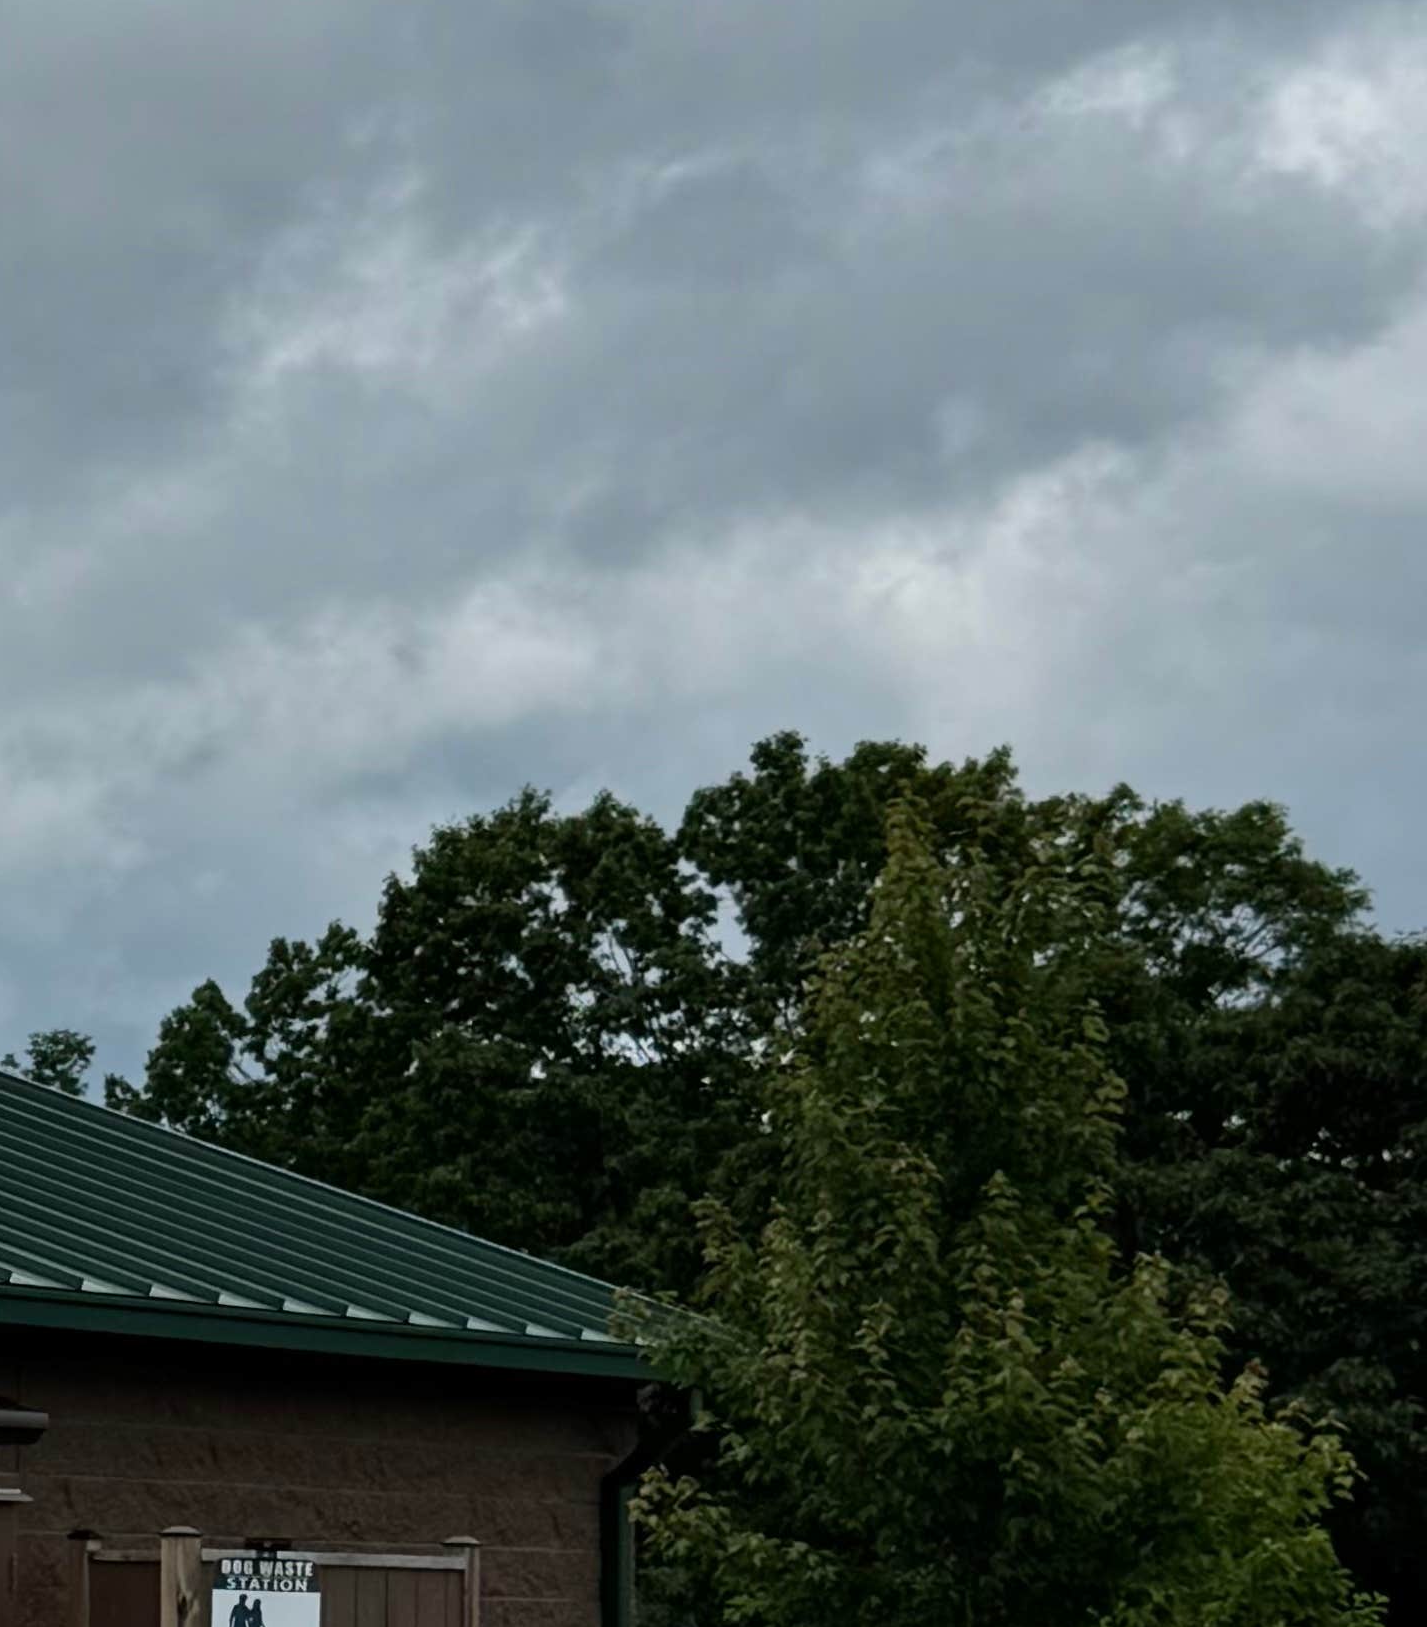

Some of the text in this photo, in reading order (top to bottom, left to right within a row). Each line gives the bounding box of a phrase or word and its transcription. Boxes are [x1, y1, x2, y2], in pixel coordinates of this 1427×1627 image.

[221, 1559, 314, 1577] DOG WASTE
[227, 1576, 307, 1591] STATION
